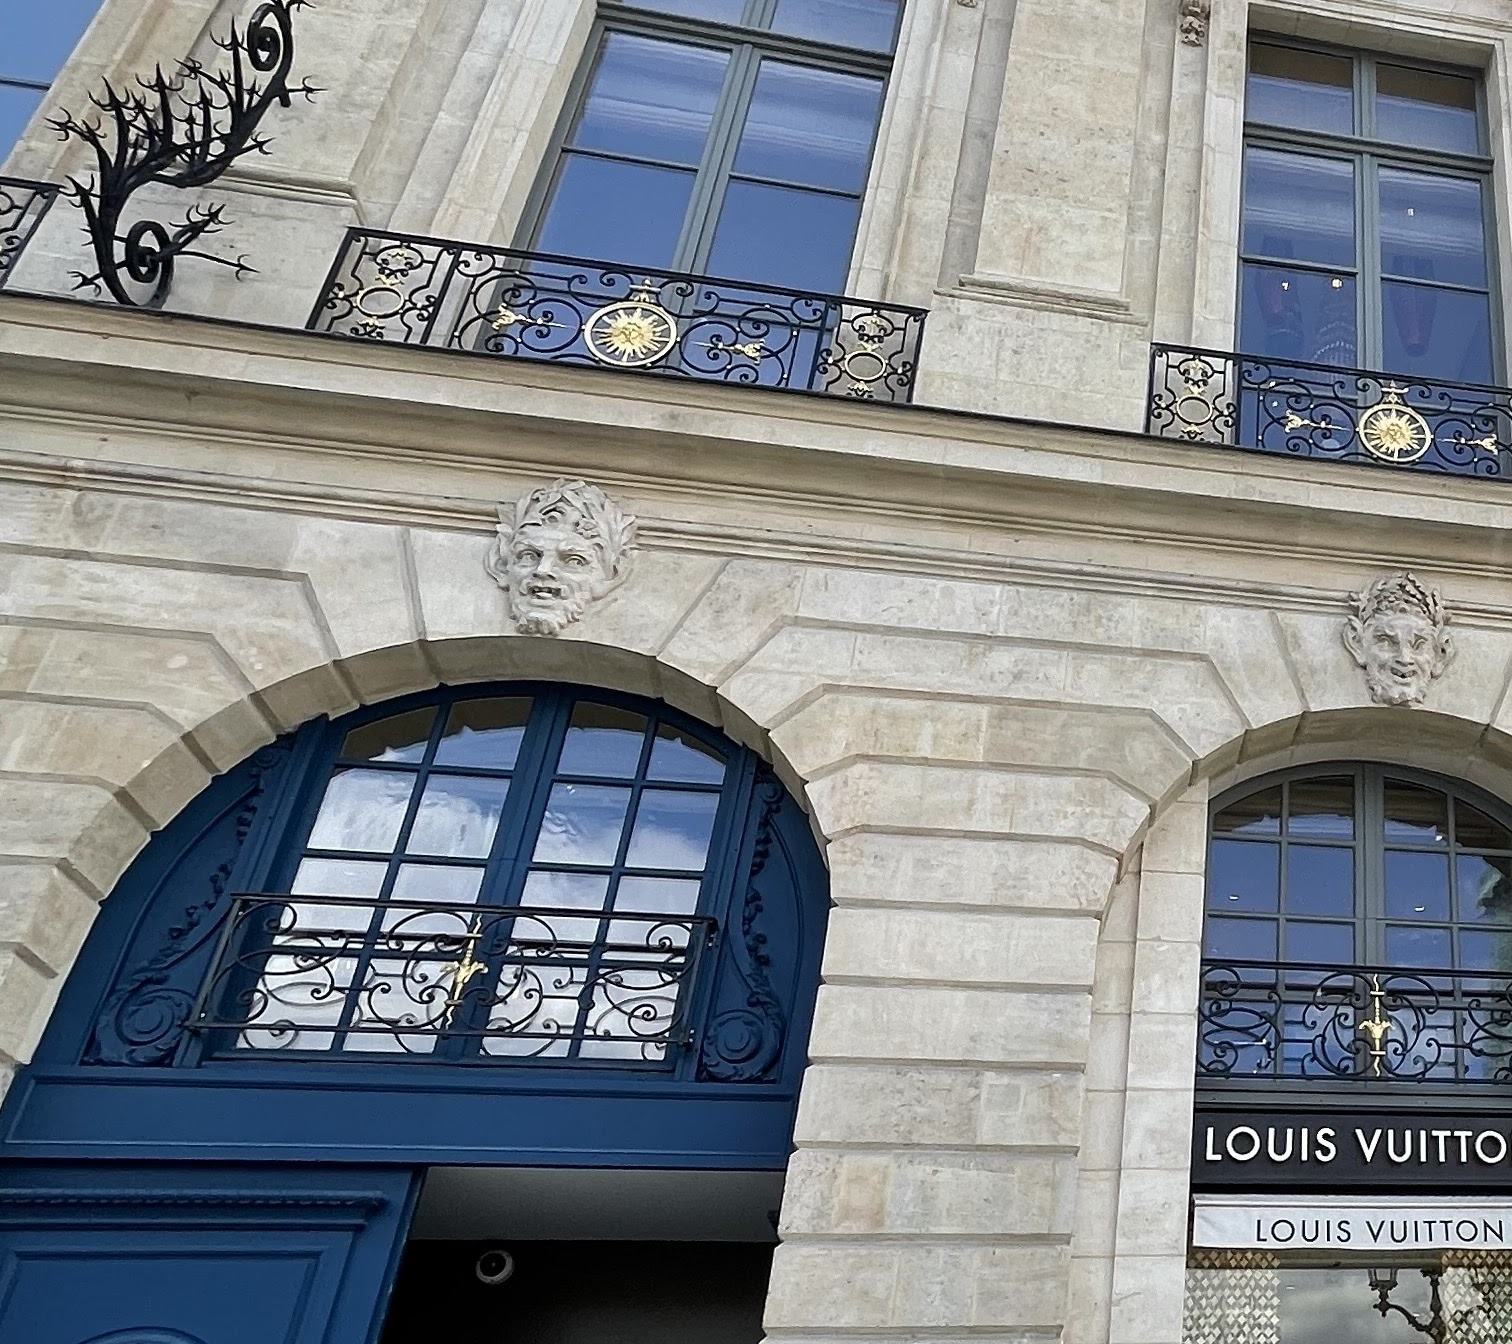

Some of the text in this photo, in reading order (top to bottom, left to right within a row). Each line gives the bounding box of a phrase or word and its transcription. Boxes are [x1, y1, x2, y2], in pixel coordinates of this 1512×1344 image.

[1204, 1125, 1337, 1163] LOUIS
[1255, 1218, 1504, 1243] LOUIS VUITTON
